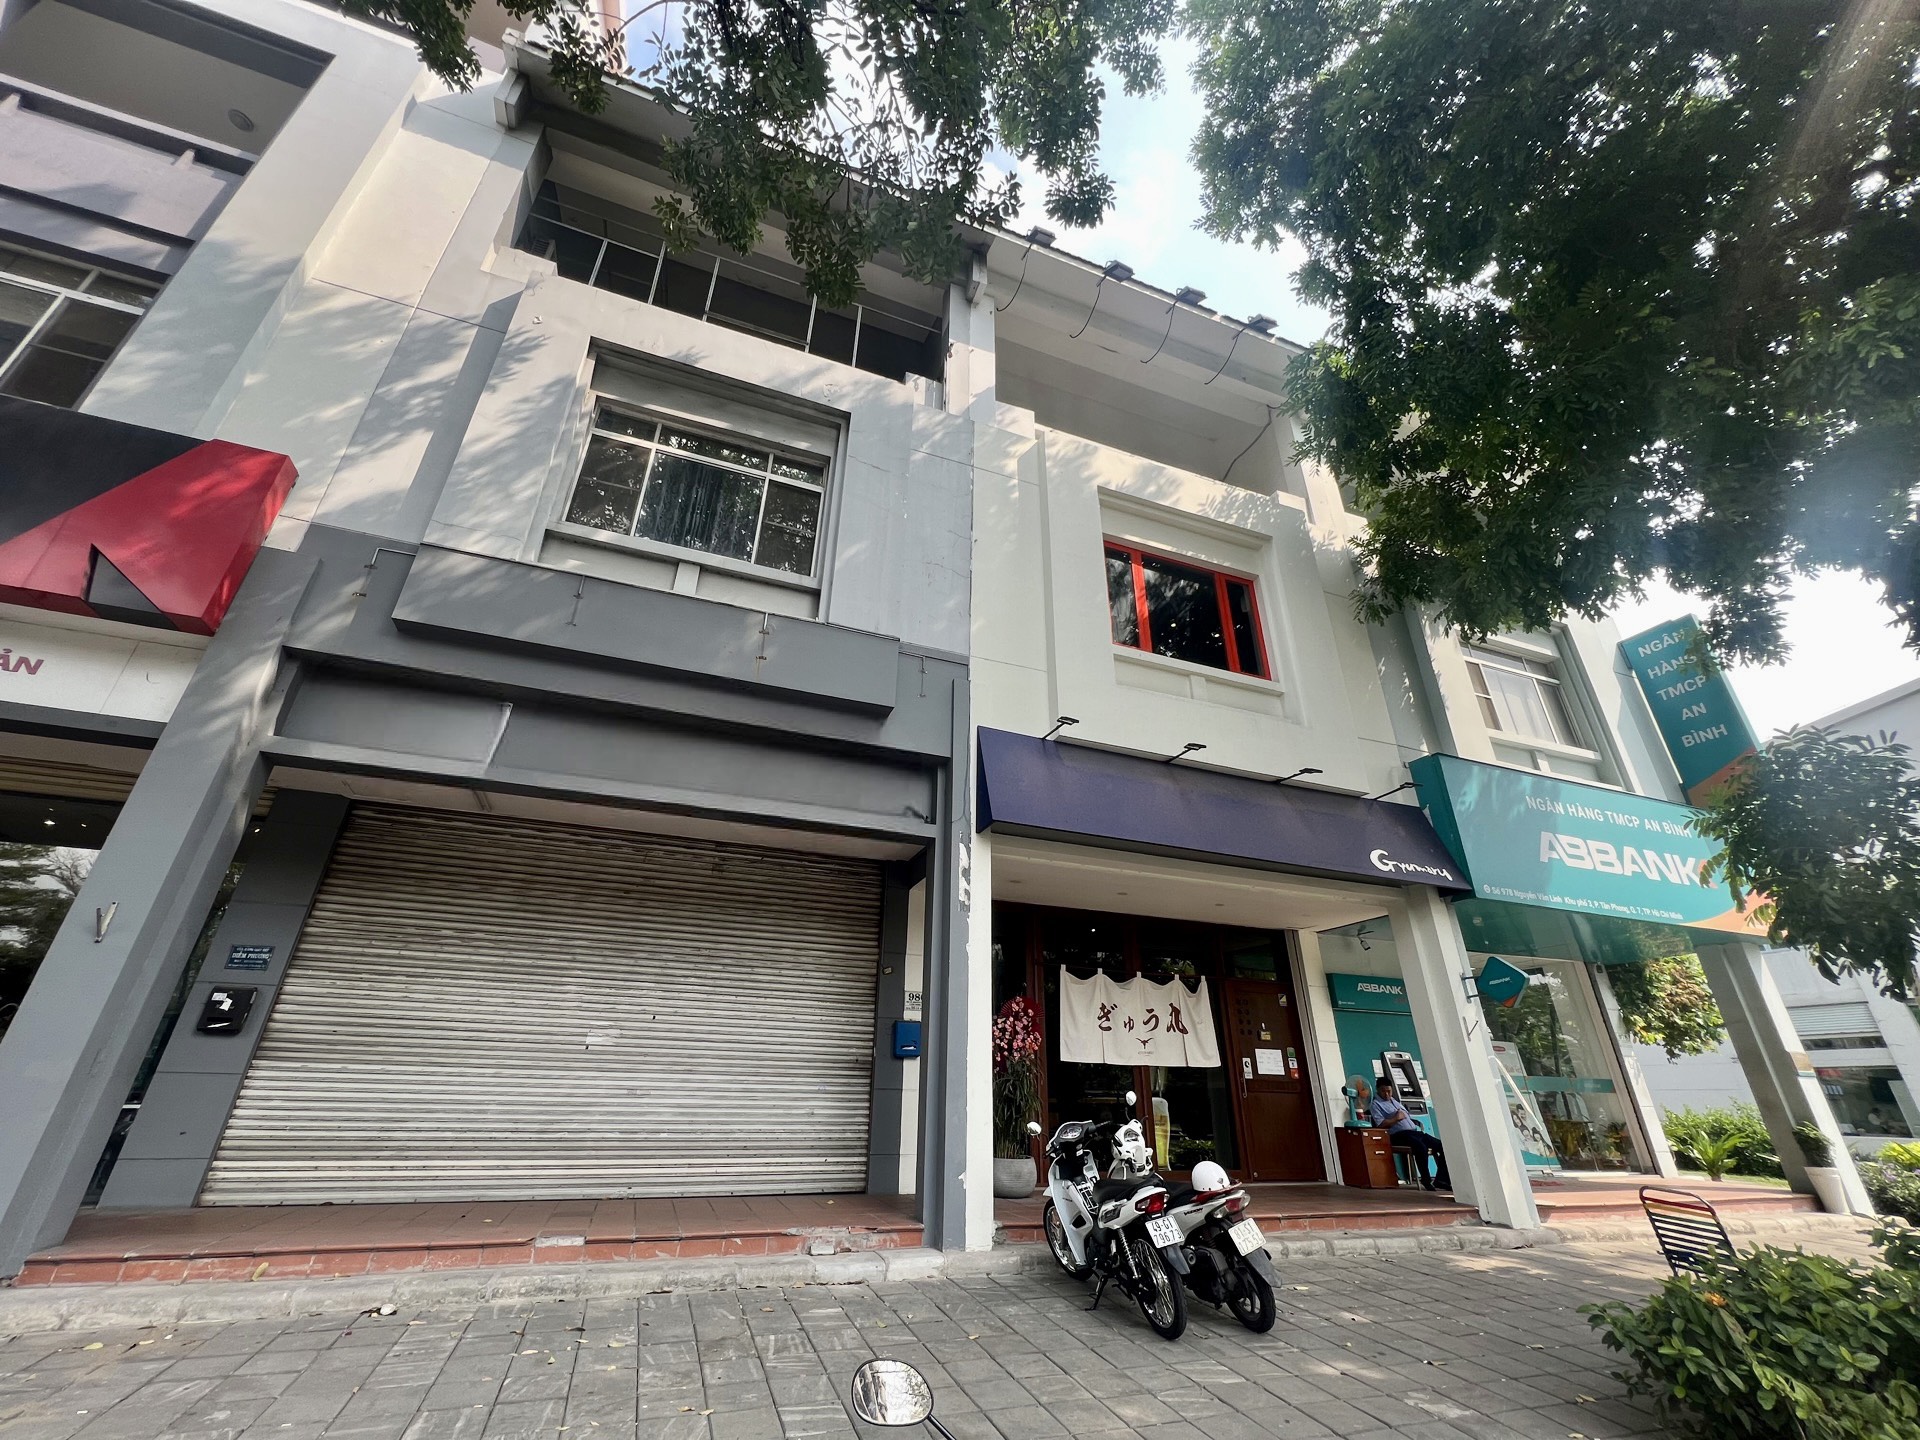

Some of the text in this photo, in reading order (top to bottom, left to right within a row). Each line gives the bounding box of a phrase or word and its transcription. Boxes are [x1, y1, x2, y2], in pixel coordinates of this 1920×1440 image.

[1637, 629, 1685, 657] NGÂN
[1656, 675, 1706, 701] TMCP
[1682, 702, 1707, 720] AN
[1681, 724, 1728, 747] BÌNH
[1525, 795, 1692, 838] NGÂN HÀNG TMCP AN BÌNH
[1539, 831, 1708, 888] ABBANK
[1549, 894, 1562, 903] Linh
[1564, 896, 1576, 905] Khu
[1576, 897, 1588, 907] phố
[1669, 911, 1684, 920] Minh
[1357, 982, 1403, 995] ABBANK
[1097, 1002, 1189, 1035] ぎゅう丸
